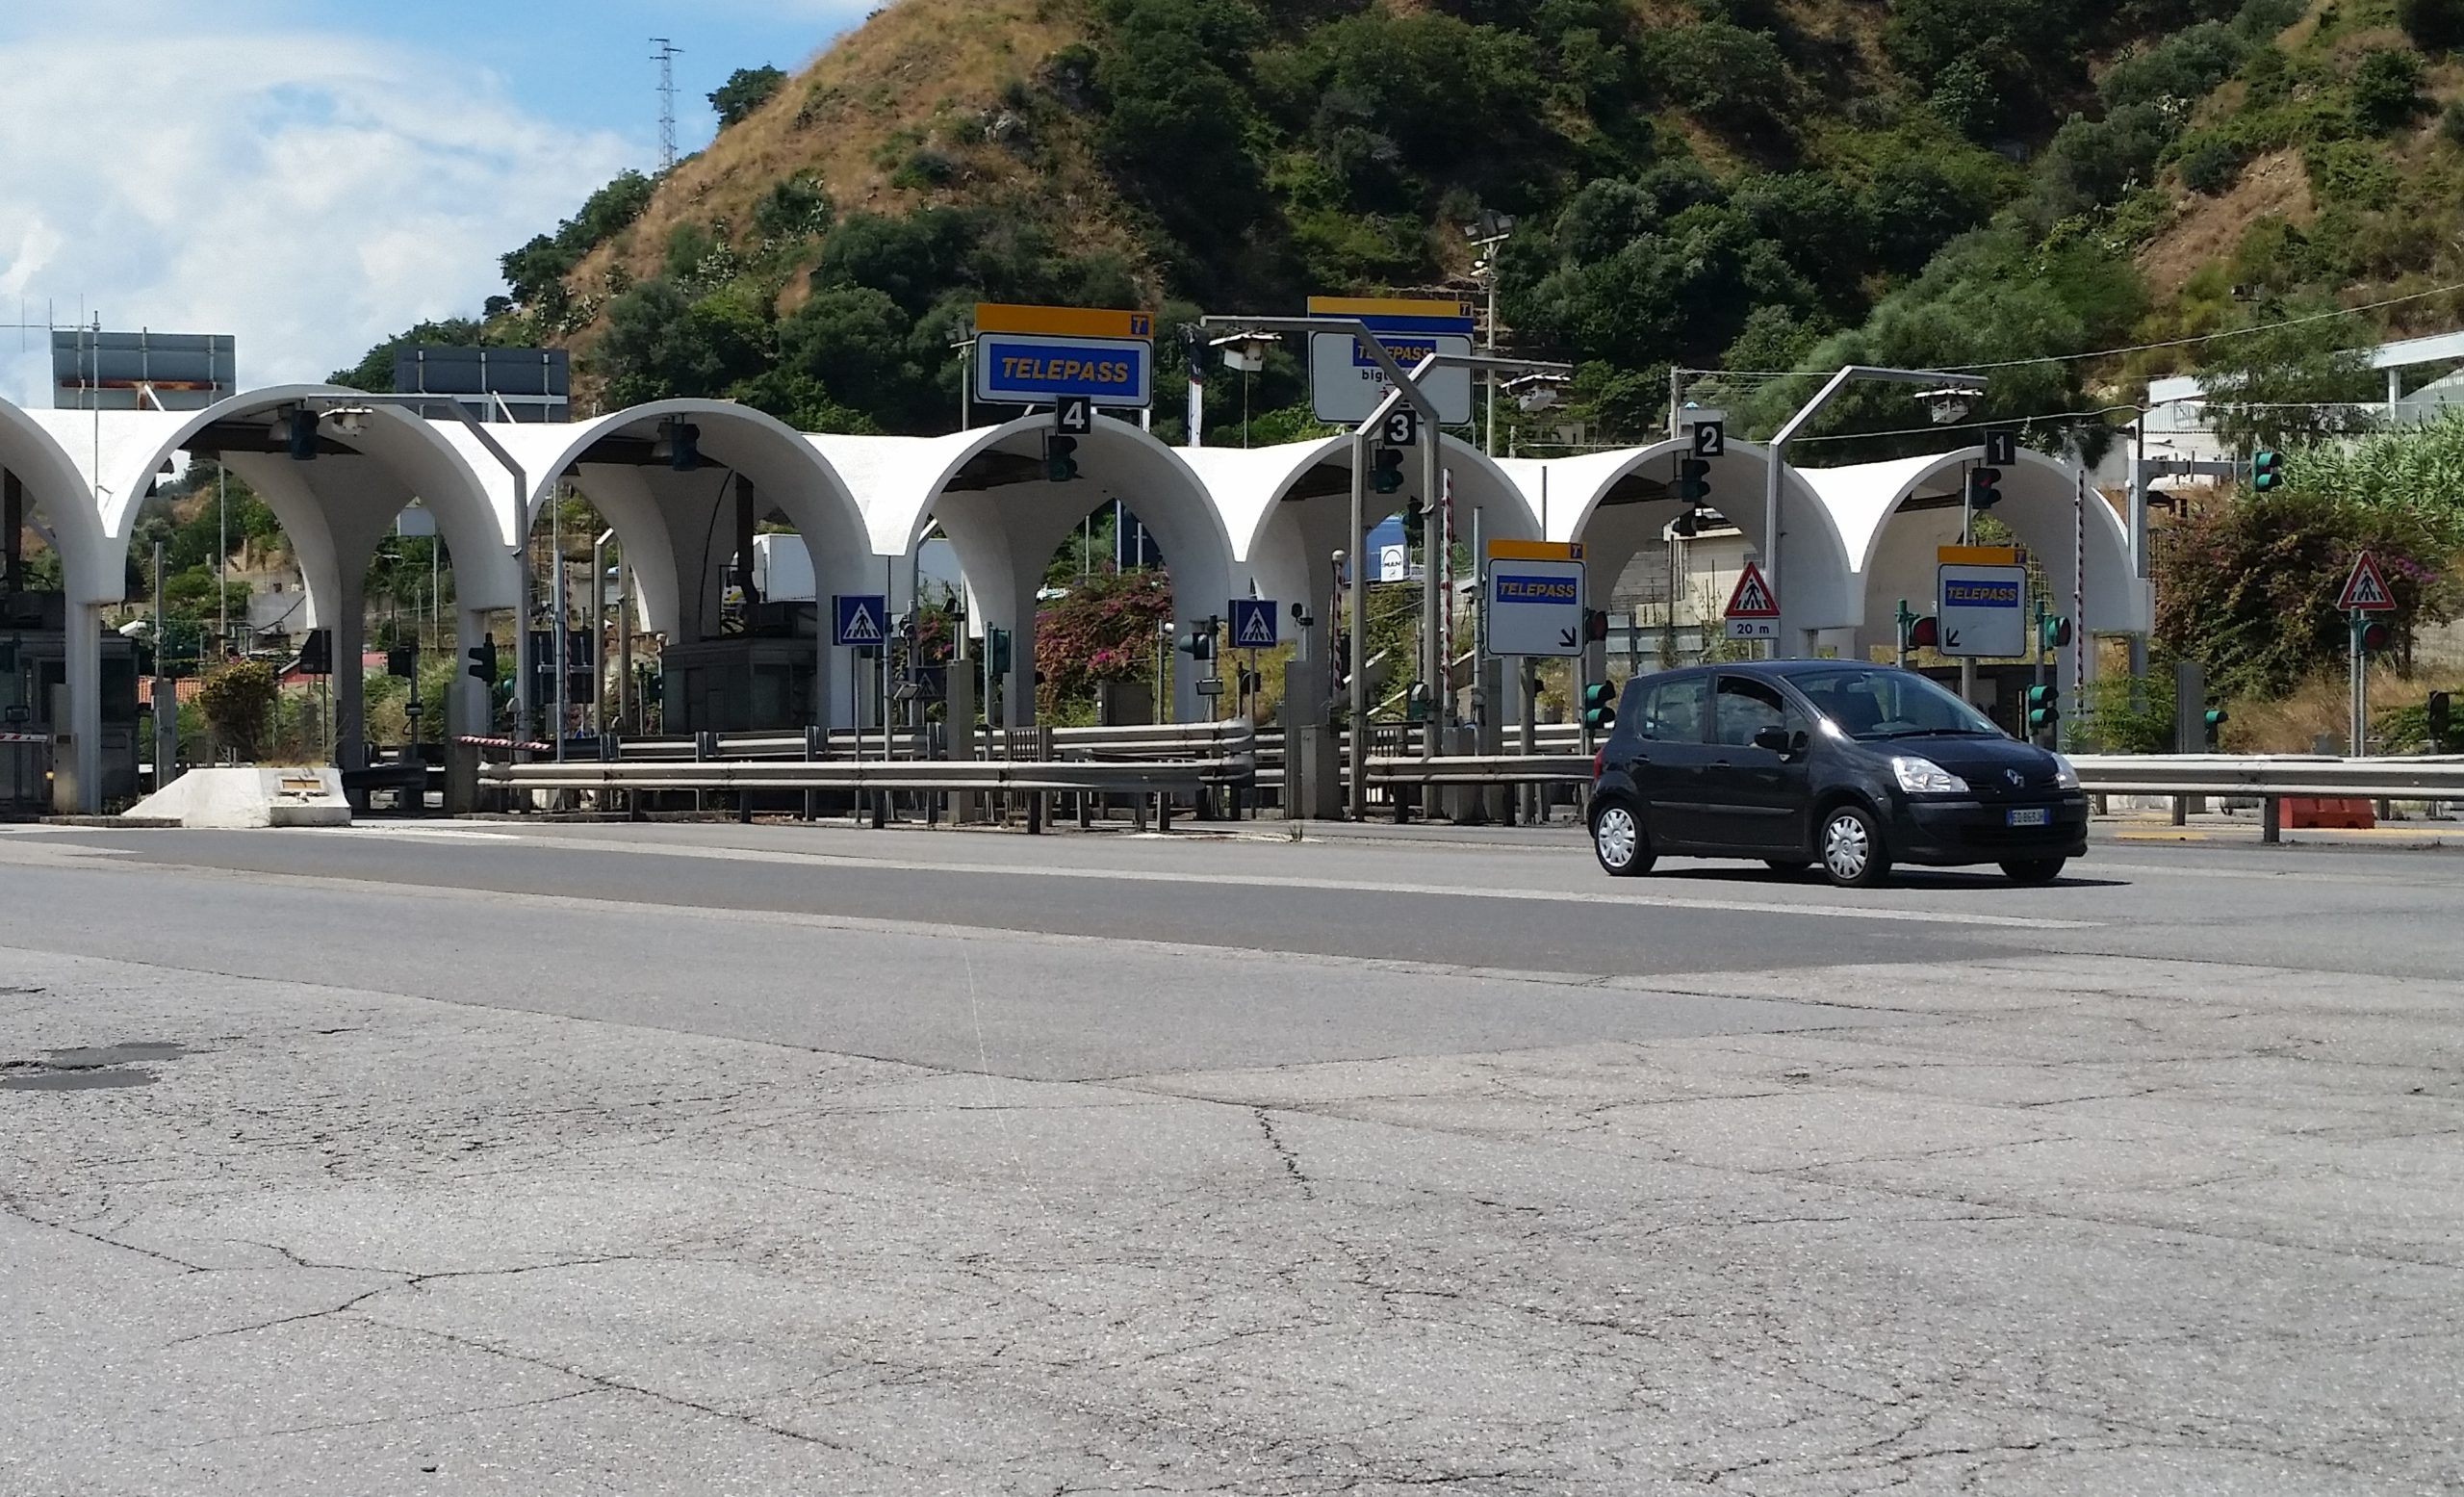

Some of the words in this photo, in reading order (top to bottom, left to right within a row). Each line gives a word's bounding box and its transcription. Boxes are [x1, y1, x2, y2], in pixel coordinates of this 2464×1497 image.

[1132, 316, 1147, 334] T
[1002, 357, 1128, 383] TELEPASS
[1063, 401, 1085, 429] 4
[1390, 414, 1409, 442] 3
[1701, 426, 1718, 452] 2
[1995, 435, 2005, 461] 1
[1500, 582, 1576, 598] TELEPASS
[1947, 586, 2017, 602] TELEPASS
[1736, 623, 1754, 634] 20
[1758, 625, 1770, 634] m
